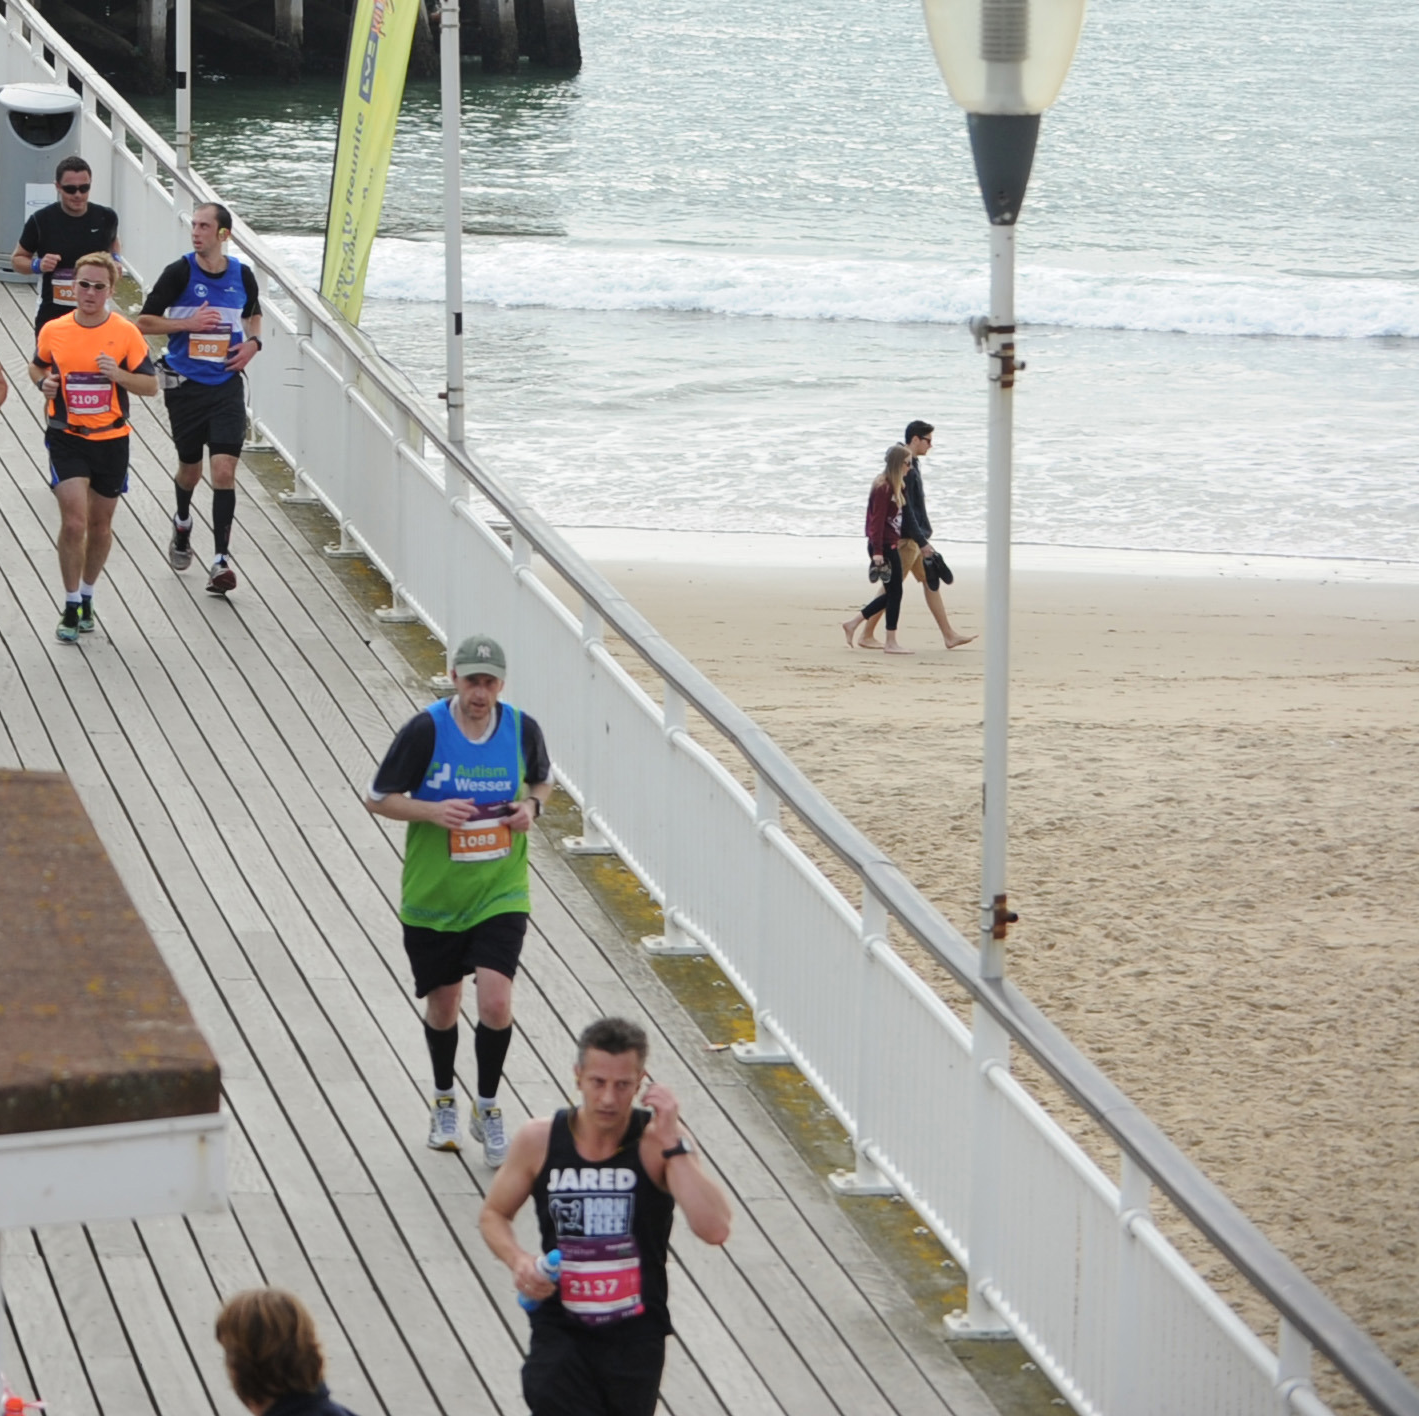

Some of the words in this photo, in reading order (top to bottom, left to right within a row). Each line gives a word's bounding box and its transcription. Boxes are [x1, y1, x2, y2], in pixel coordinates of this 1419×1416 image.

[346, 111, 365, 207] Reunite
[197, 343, 219, 354] 989
[71, 394, 100, 405] 2109
[455, 764, 508, 778] Autism
[454, 777, 512, 792] Wessex
[458, 833, 497, 848] 1088
[547, 1168, 637, 1192] JARED
[583, 1197, 629, 1216] BORN
[583, 1216, 628, 1236] FREE
[569, 1278, 619, 1296] 2137
